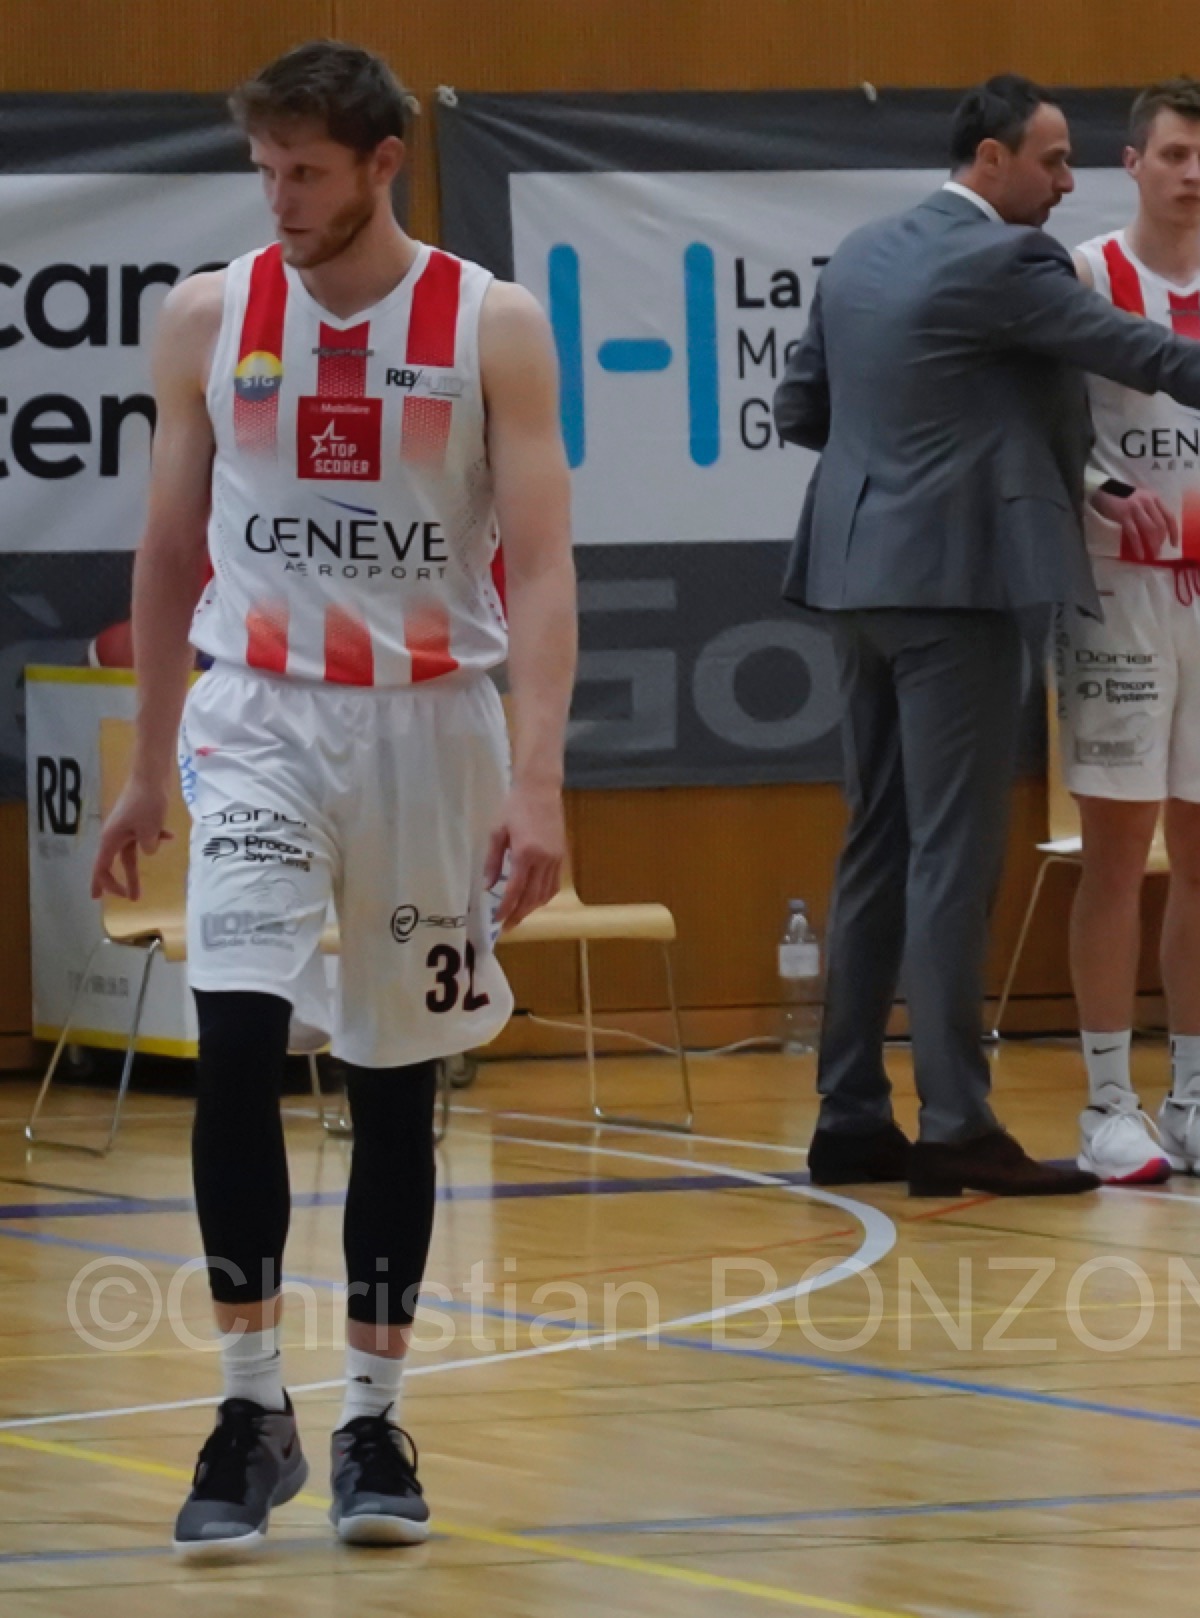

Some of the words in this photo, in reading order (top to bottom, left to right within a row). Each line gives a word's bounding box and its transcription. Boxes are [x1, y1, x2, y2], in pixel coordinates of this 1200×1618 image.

[330, 443, 358, 457] TOP
[314, 459, 370, 474] SCORER
[36, 756, 82, 835] RB
